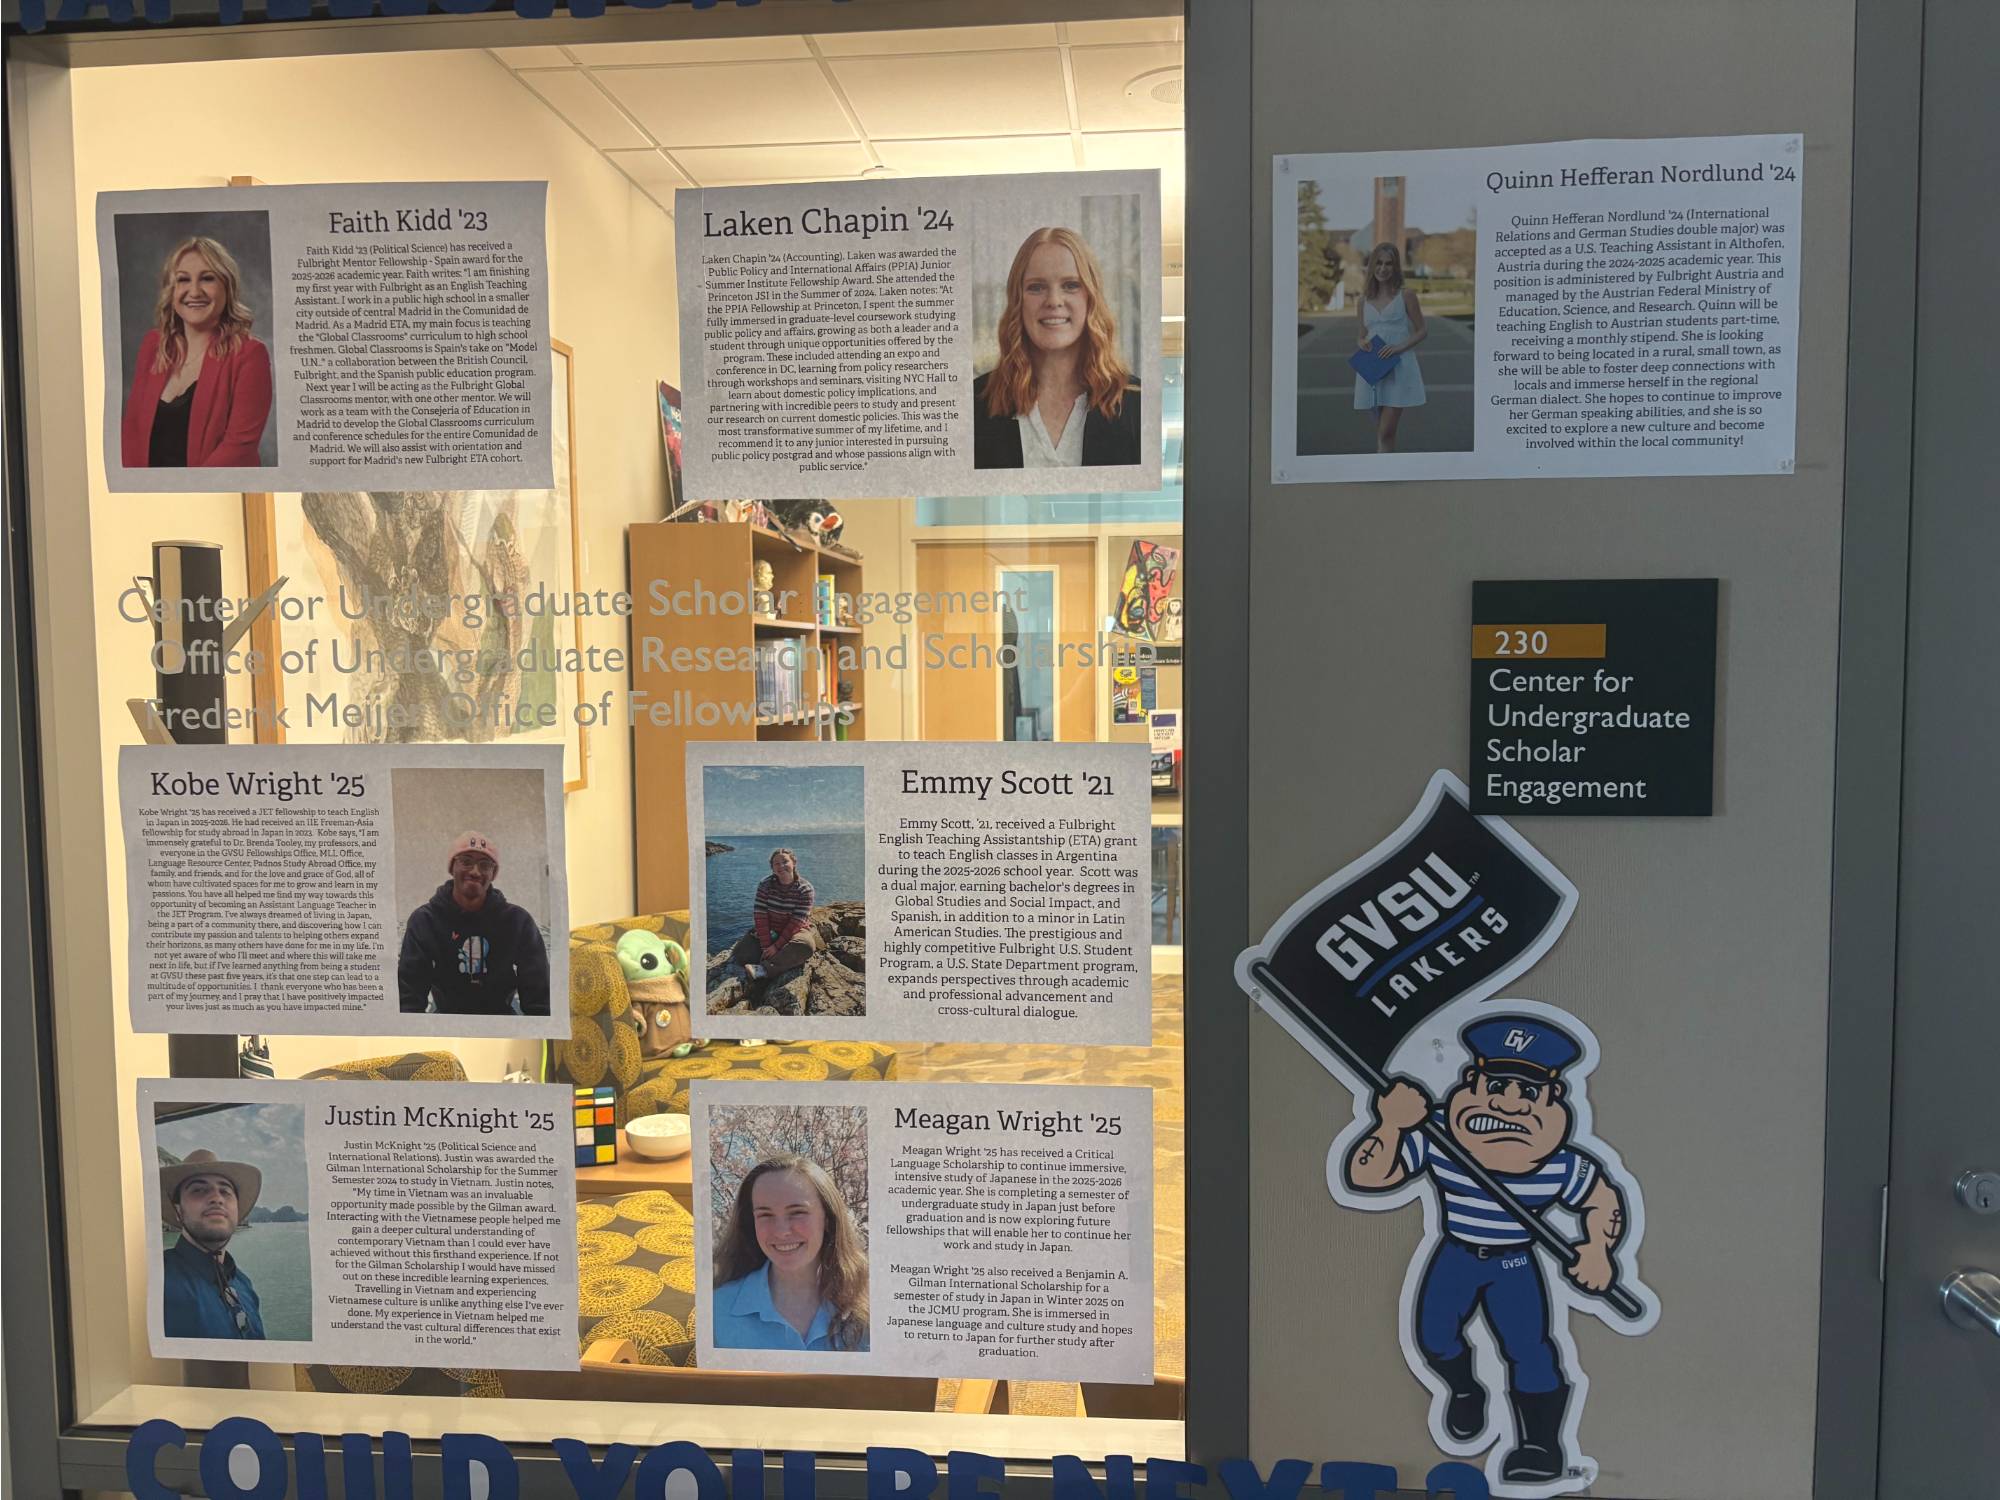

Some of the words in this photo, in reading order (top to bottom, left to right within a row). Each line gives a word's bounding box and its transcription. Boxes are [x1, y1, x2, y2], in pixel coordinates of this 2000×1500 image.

[1486, 170, 1554, 194] Quinn
[1559, 166, 1654, 187] Hefferan
[1660, 162, 1764, 183] Nordlund
[1769, 163, 1796, 182] '24
[328, 209, 390, 233] Faith
[395, 207, 452, 232] Kidd
[458, 208, 488, 231] '23
[703, 210, 794, 237] Laken
[801, 205, 909, 239] Chapin
[917, 206, 954, 231] '24
[1511, 214, 1549, 229] Quinn
[1552, 212, 1604, 224] Hefferan
[1607, 209, 1666, 222] Nordlund
[1668, 209, 1684, 221] '24
[1686, 206, 1769, 221] (International
[305, 245, 330, 256] Faith
[331, 244, 354, 255] Kidd
[369, 243, 410, 255] (Political
[410, 242, 448, 253] Science)
[449, 241, 466, 252] has
[467, 240, 506, 253] received
[507, 242, 513, 250] a
[707, 292, 753, 302] Princeton
[754, 290, 770, 300] JSI
[771, 290, 781, 300] in
[783, 290, 799, 300] the
[800, 289, 841, 299] Summer
[841, 287, 853, 298] of
[879, 286, 908, 296] Laken
[1505, 289, 1559, 304] managed
[1562, 288, 1577, 303] by
[1579, 288, 1600, 300] the
[1601, 286, 1654, 299] Austrian
[1658, 283, 1701, 297] Federal
[1704, 283, 1756, 297] Ministry
[1758, 282, 1772, 294] of
[728, 390, 752, 400] learn
[753, 389, 781, 400] about
[782, 387, 825, 398] domestic
[827, 387, 856, 400] policy
[918, 385, 937, 395] and
[1525, 437, 1575, 449] involved
[1577, 436, 1616, 448] within
[1619, 436, 1639, 448] the
[1641, 435, 1669, 447] local
[1671, 434, 1743, 448] community!
[309, 457, 346, 468] support
[347, 455, 362, 465] for
[363, 454, 403, 465] Madrid's
[404, 456, 424, 464] new
[425, 453, 468, 466] Fulbright
[470, 453, 489, 463] ETA
[118, 587, 250, 623] Center
[267, 586, 324, 621] for
[339, 581, 632, 629] Undergraduate
[649, 579, 798, 616] Scholar
[812, 582, 1029, 624] Engagement
[1495, 630, 1548, 655] 230
[151, 639, 265, 675] Office
[280, 638, 318, 674] of
[332, 637, 624, 683] Undergraduate
[642, 634, 821, 673] Research
[838, 634, 907, 670] and
[925, 631, 1157, 678] Scholarship
[1489, 668, 1584, 692] Center
[1593, 669, 1634, 693] for
[306, 692, 417, 737] Meijer
[442, 691, 557, 728] Office
[573, 690, 614, 727] of
[627, 689, 856, 737] Fellowships
[1488, 703, 1690, 735] Undergraduate
[1487, 738, 1585, 762] Scholar
[150, 771, 219, 796] Kobe
[226, 770, 323, 802] Wright
[330, 772, 365, 797] '25
[901, 769, 993, 800] Emmy
[1001, 769, 1073, 795] Scott
[1082, 771, 1114, 795] '21
[1487, 773, 1647, 804] Engagement
[899, 817, 938, 832] Emmy
[940, 817, 974, 830] Scott,
[976, 818, 993, 830] '21,
[995, 818, 1046, 830] received
[1048, 821, 1055, 830] a
[1058, 818, 1116, 833] Fulbright
[1315, 851, 1472, 981] GVSU
[893, 925, 951, 937] American
[954, 926, 1002, 938] Studies.
[1003, 926, 1026, 938] The
[1028, 927, 1097, 942] prestigious
[1099, 928, 1122, 940] and
[1370, 906, 1509, 1018] LAKERS
[937, 1004, 1020, 1016] cross-cultural
[1023, 1005, 1078, 1021] dialogue.
[324, 1104, 397, 1126] Justin
[403, 1106, 519, 1134] McKnight
[524, 1109, 554, 1131] '25
[894, 1107, 990, 1135] Meagan
[996, 1110, 1083, 1138] Wright
[1090, 1113, 1122, 1136] '25
[343, 1140, 373, 1150] Justin
[375, 1140, 422, 1152] McKnight
[437, 1141, 480, 1152] (Political
[481, 1142, 517, 1152] Science
[518, 1143, 536, 1152] and
[902, 1145, 942, 1158] Meagan
[945, 1145, 981, 1158] Wright
[983, 1147, 997, 1157] '25
[999, 1146, 1018, 1157] has
[1020, 1147, 1065, 1158] received
[1066, 1150, 1072, 1158] a
[1074, 1149, 1114, 1160] Critical
[906, 1211, 964, 1224] graduation
[965, 1213, 986, 1223] and
[987, 1213, 997, 1224] is
[999, 1216, 1022, 1224] now
[1024, 1214, 1075, 1228] exploring
[1076, 1215, 1111, 1227] future
[1502, 1256, 1527, 1269] GVSU
[354, 1283, 402, 1296] Travelling
[403, 1284, 413, 1294] in
[414, 1285, 454, 1295] Vietnam
[456, 1286, 474, 1296] and
[476, 1287, 536, 1299] experiencing
[415, 1334, 424, 1343] in
[426, 1334, 442, 1344] the
[978, 1346, 1038, 1358] graduation.
